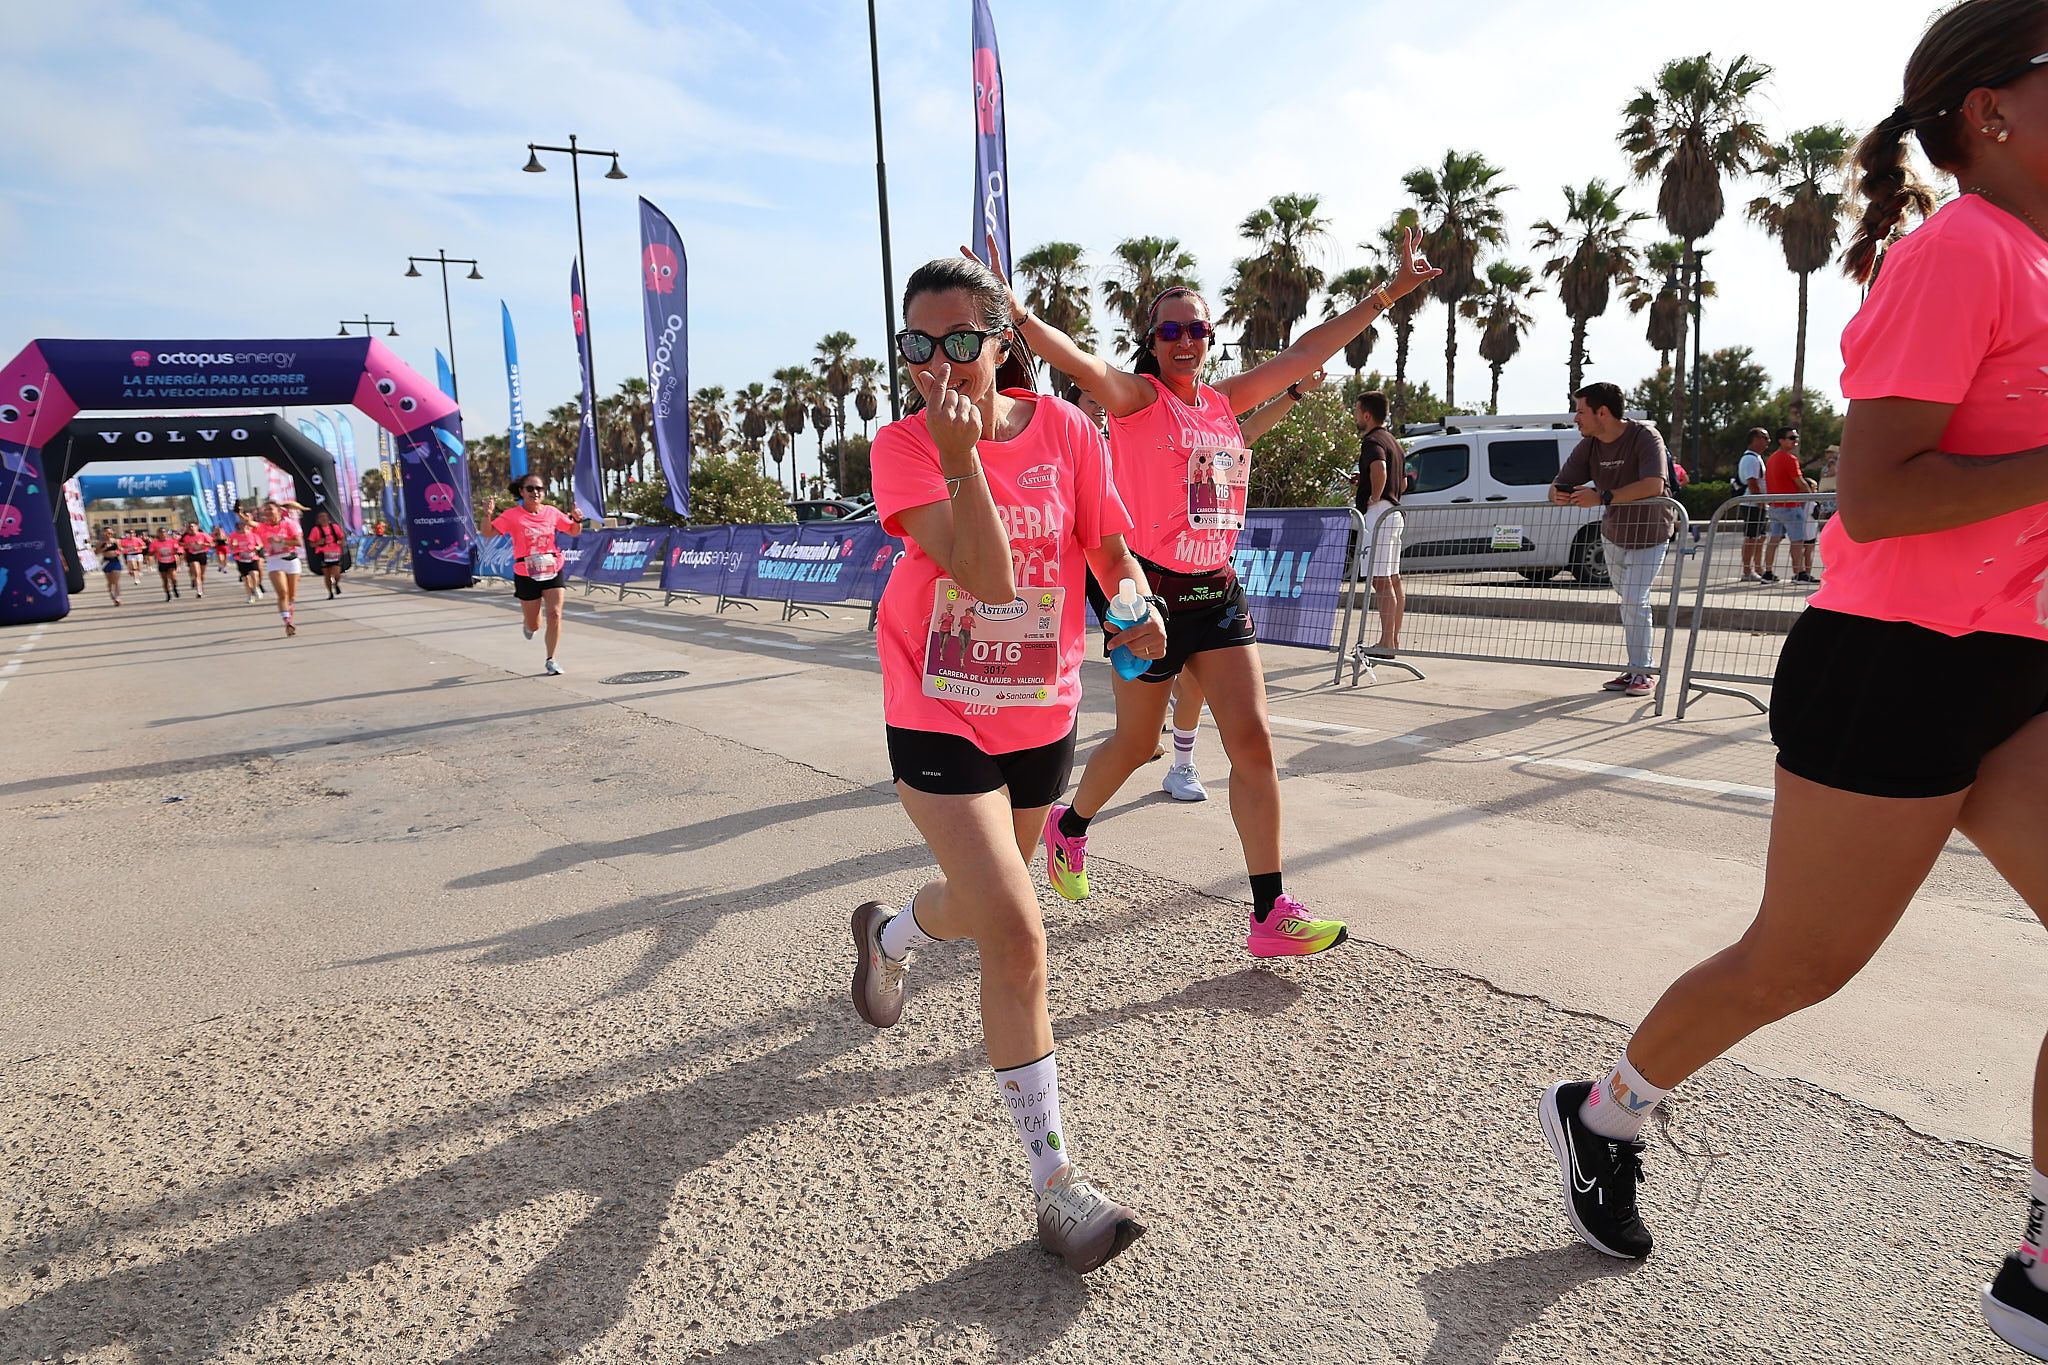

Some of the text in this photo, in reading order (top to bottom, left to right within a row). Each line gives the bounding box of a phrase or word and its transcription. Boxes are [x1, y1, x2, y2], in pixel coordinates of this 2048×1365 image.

[123, 372, 305, 385] LA ENERGÍA PARA CORRER
[123, 386, 309, 398] A LA VELOCIDAD DE LA LUZ
[98, 428, 249, 444] VOLVO
[1229, 549, 1311, 598] ENA!
[1179, 590, 1223, 602] HANKER
[978, 602, 1024, 615] ASTURIANA
[972, 641, 1022, 662] 016
[938, 668, 968, 680] CARRERA
[980, 675, 989, 683] LA
[990, 676, 1012, 684] MUJER
[1016, 676, 1045, 684] VALENCIA
[984, 665, 1008, 675] 3017
